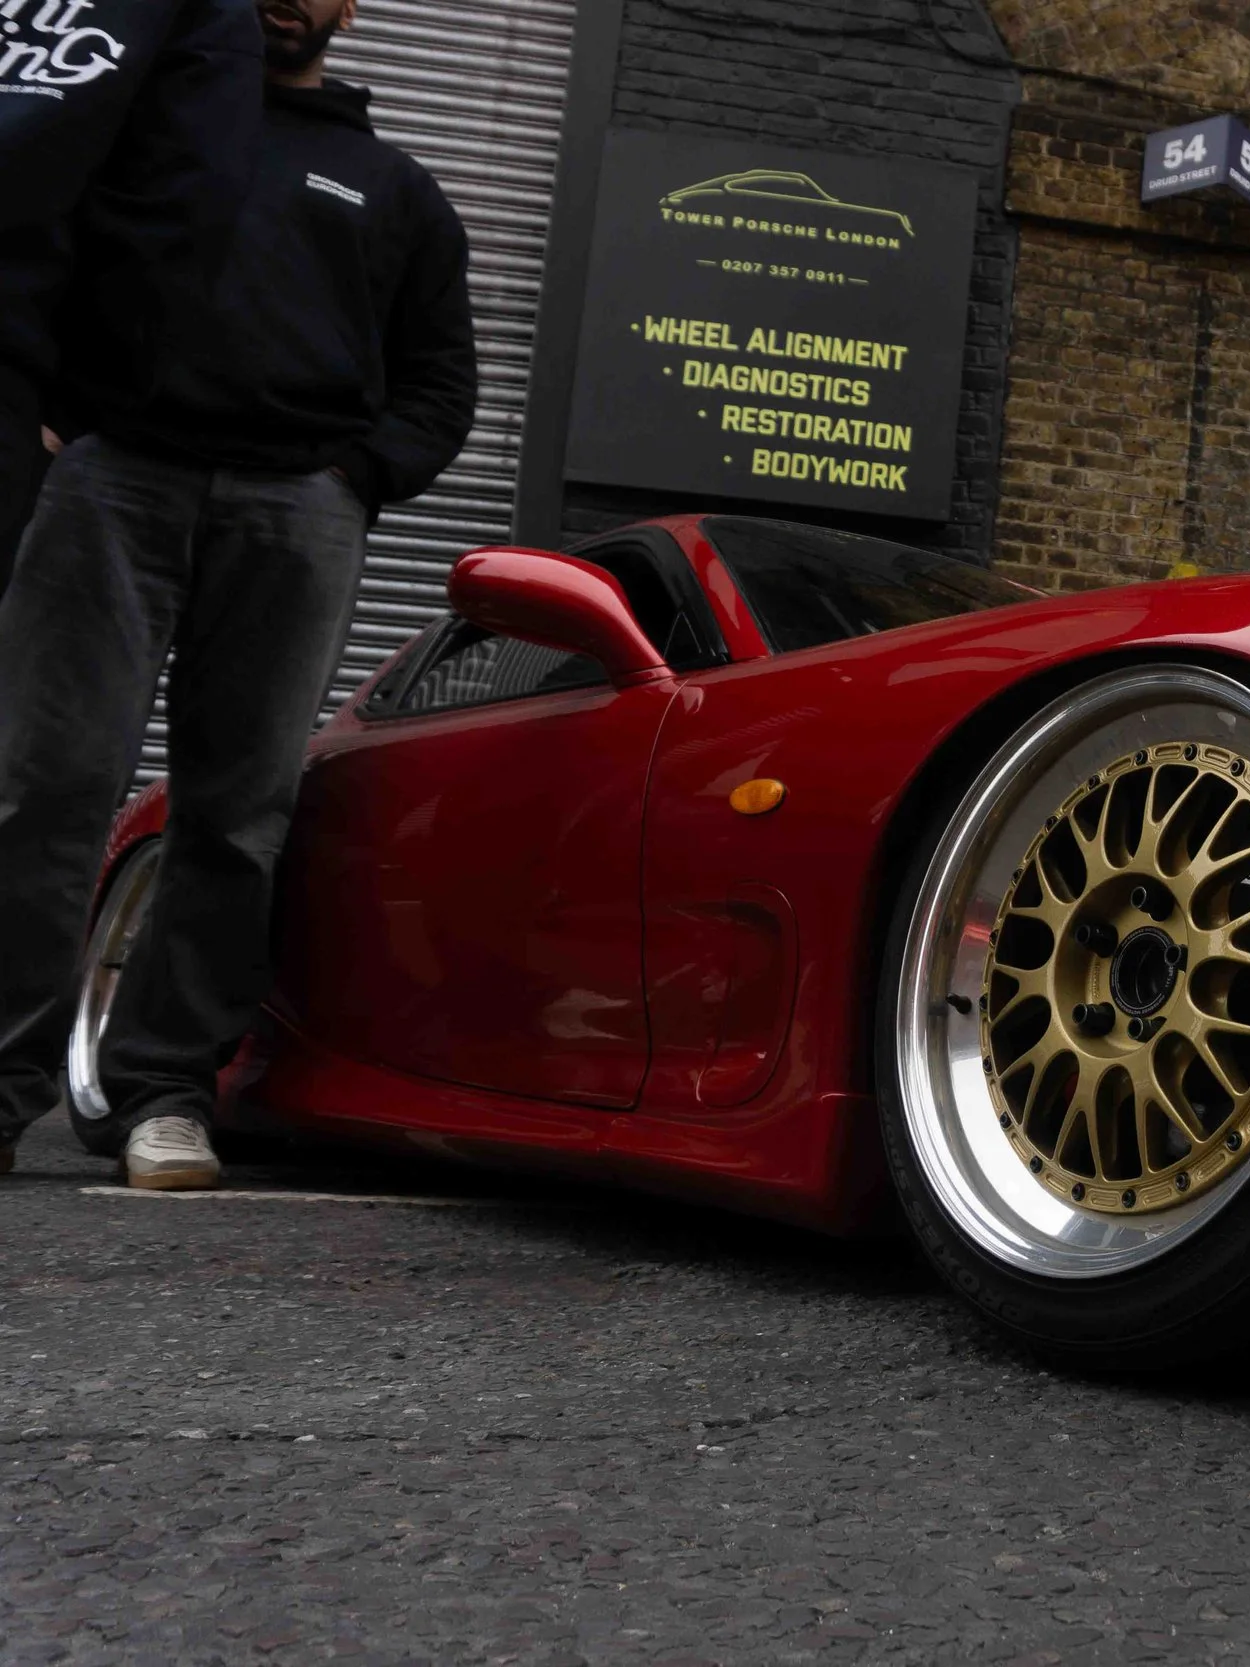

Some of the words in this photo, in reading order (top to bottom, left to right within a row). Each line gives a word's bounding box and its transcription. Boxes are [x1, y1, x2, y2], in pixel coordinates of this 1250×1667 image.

[1162, 133, 1207, 170] 54
[1148, 174, 1179, 190] DRUID
[1180, 165, 1217, 182] STREET
[721, 258, 763, 274] 0207
[768, 264, 800, 279] 357
[805, 268, 845, 285] 0911
[645, 315, 739, 351] WHEEL
[746, 327, 908, 371] ALIGNMENT
[682, 359, 870, 407] DIAGNOSTICS
[721, 404, 911, 452] RESTORATION
[752, 448, 908, 492] BODYWORK
